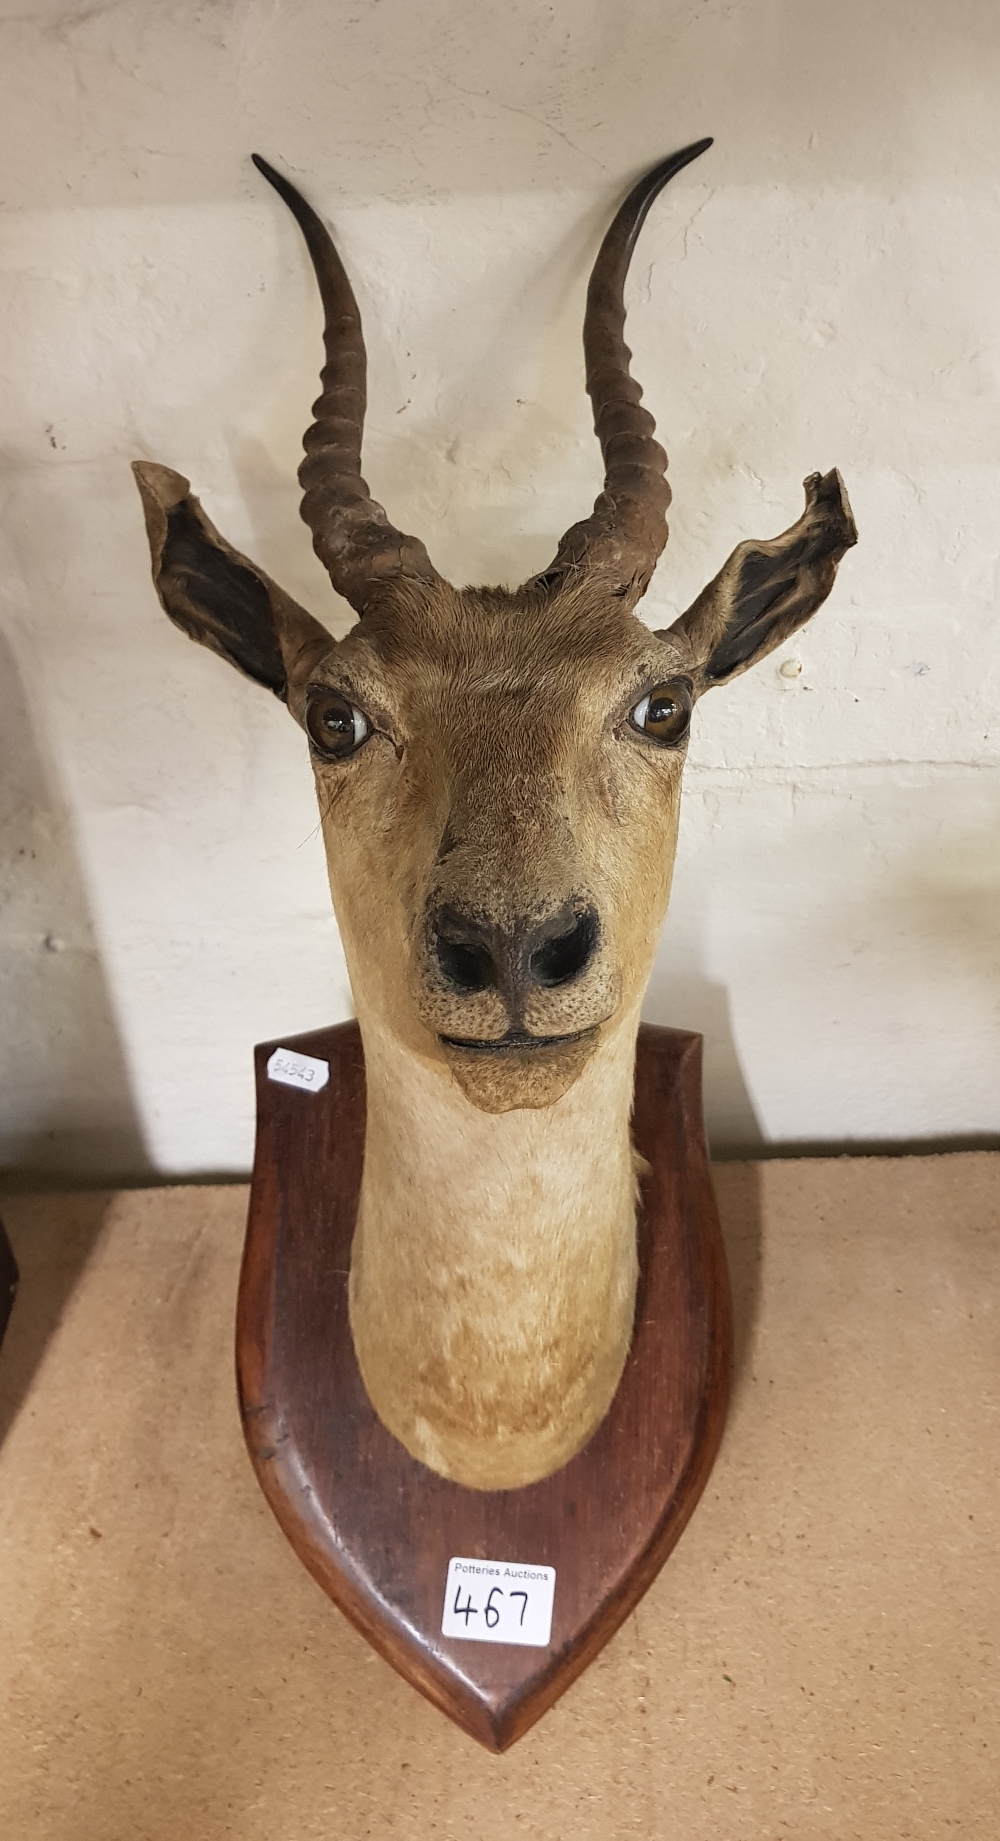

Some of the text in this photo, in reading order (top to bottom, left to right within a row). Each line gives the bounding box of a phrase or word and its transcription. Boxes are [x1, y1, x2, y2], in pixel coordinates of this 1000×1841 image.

[273, 1058, 315, 1081] 54543
[454, 1563, 549, 1581] Potteries Auctions
[454, 1585, 528, 1628] 467
